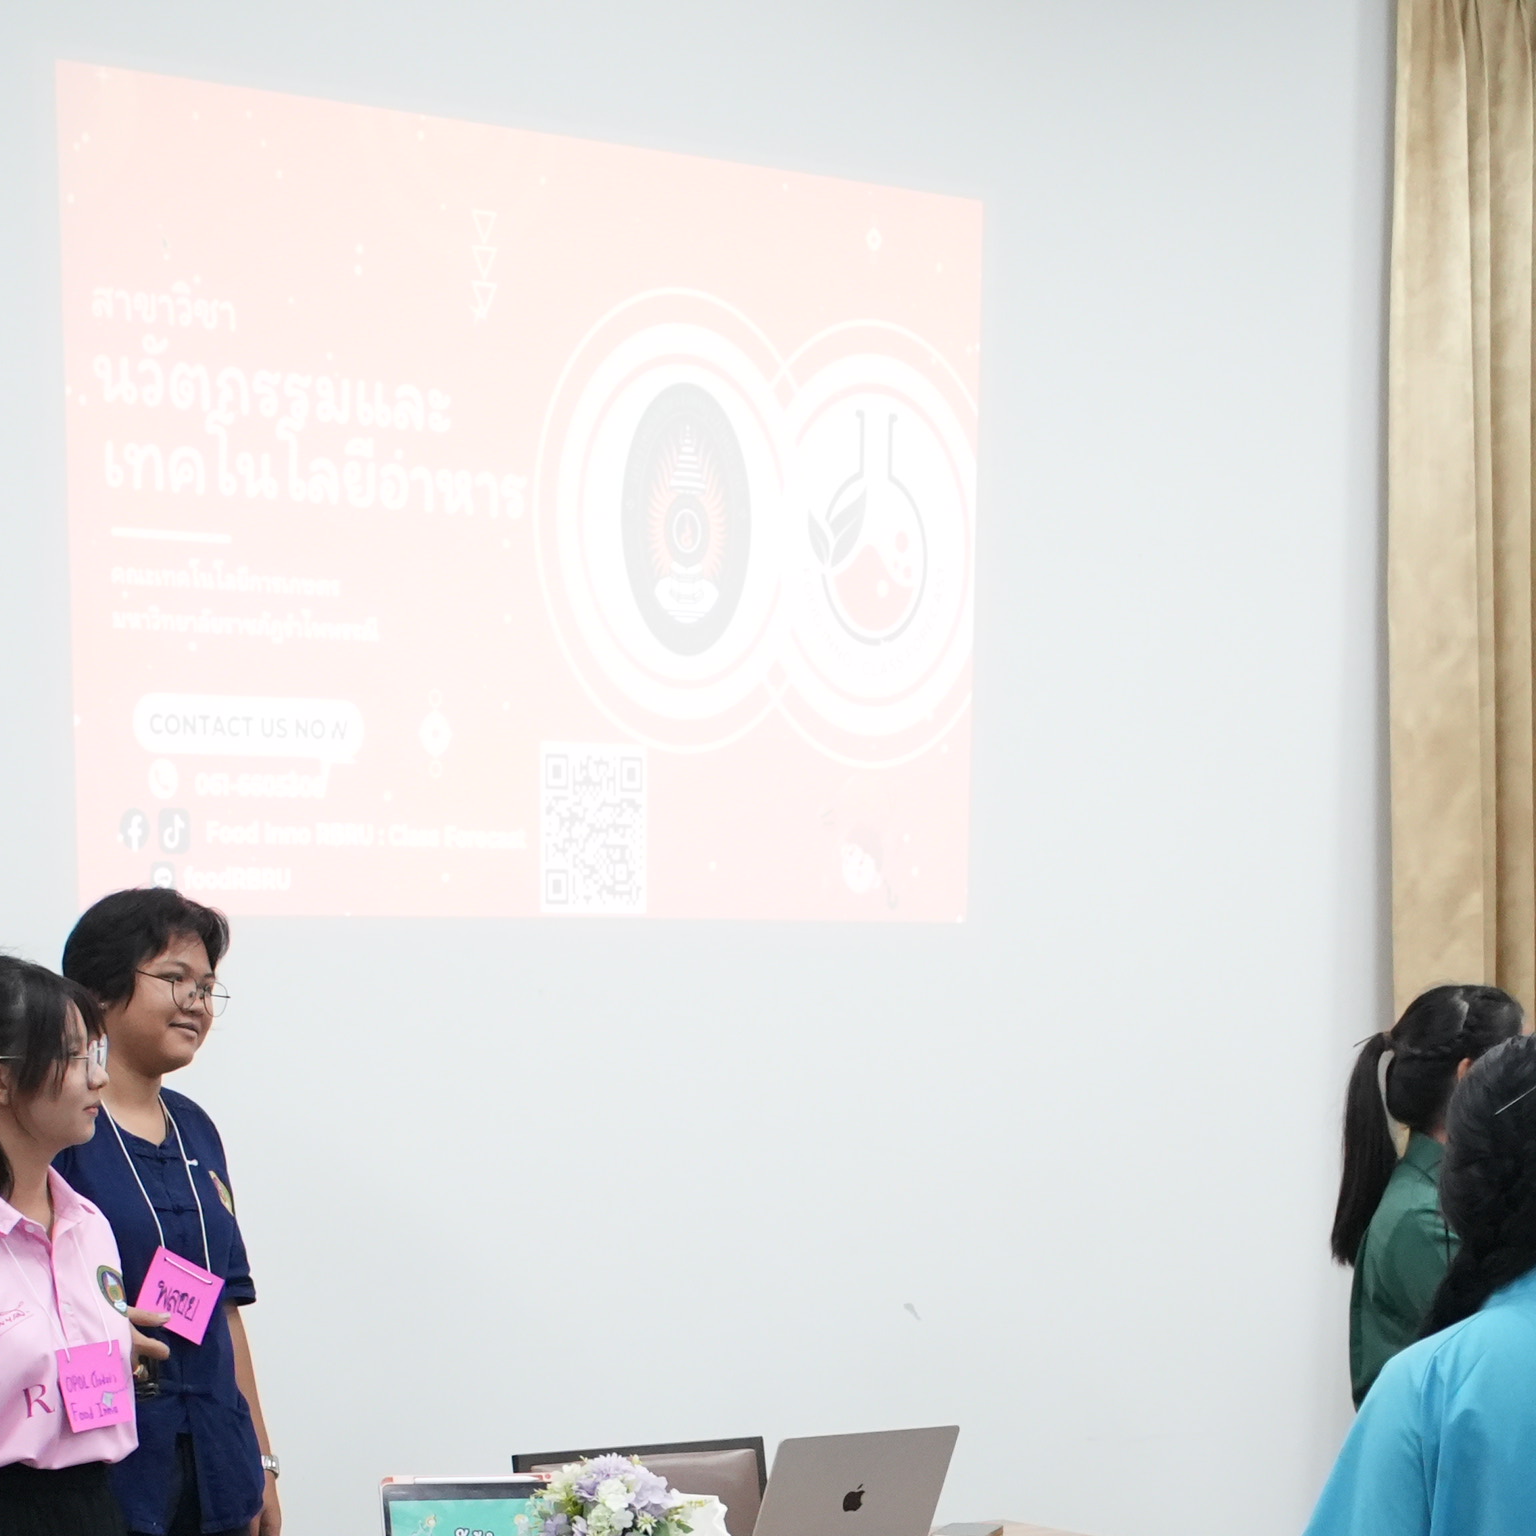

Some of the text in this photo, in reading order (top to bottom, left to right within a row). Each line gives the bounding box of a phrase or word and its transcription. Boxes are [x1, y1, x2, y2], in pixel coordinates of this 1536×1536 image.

[91, 281, 237, 333] สาขาวิชา
[92, 333, 453, 434] นวัตกรรมและ
[149, 713, 254, 738] CONTACT
[261, 717, 288, 739] US
